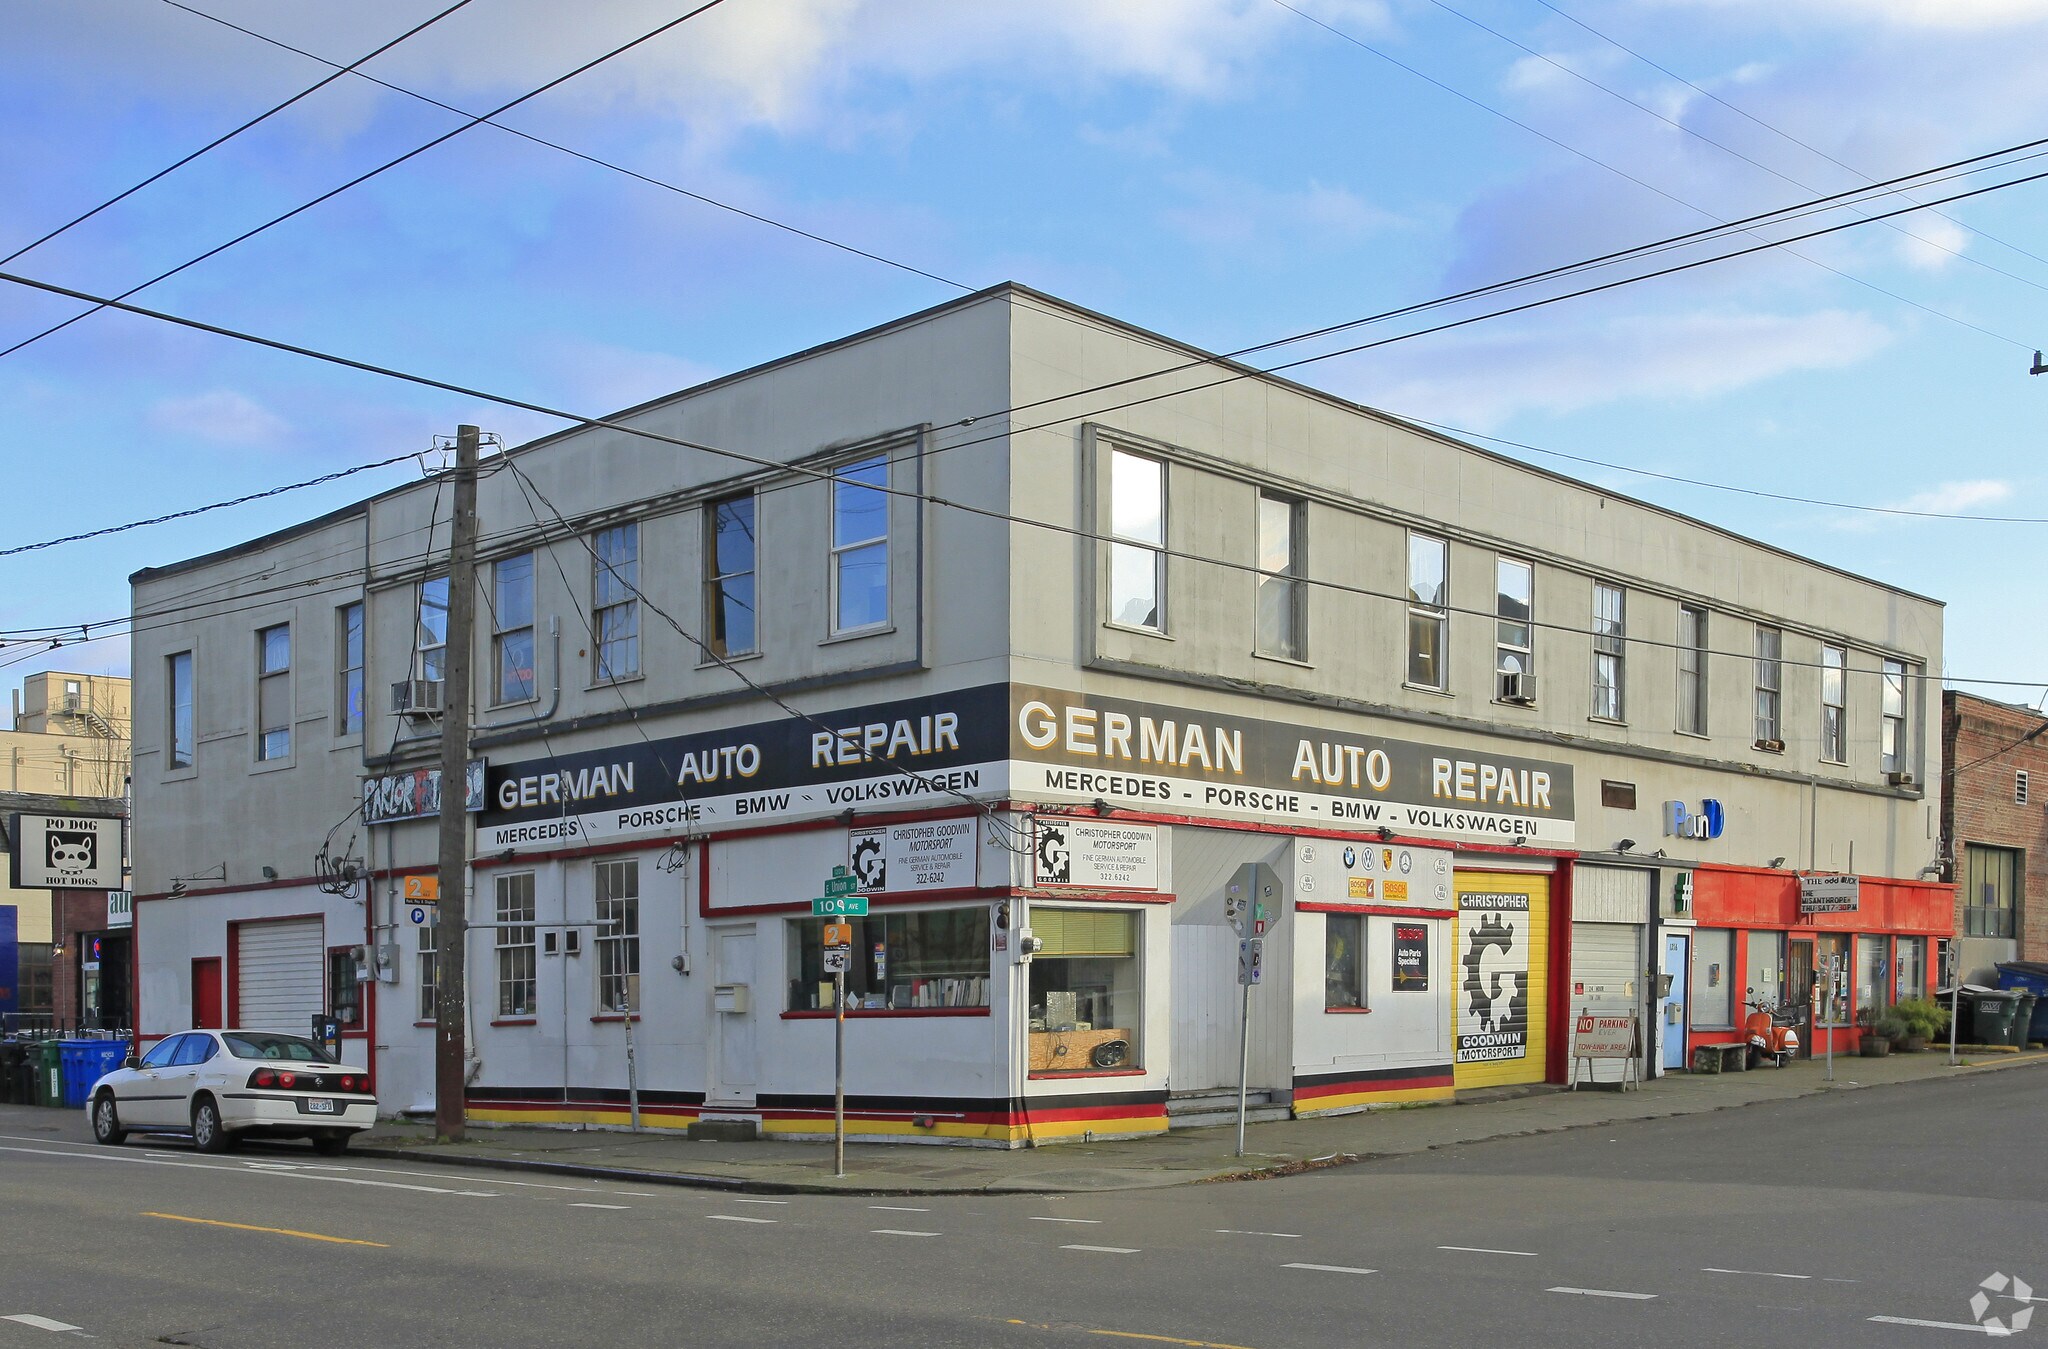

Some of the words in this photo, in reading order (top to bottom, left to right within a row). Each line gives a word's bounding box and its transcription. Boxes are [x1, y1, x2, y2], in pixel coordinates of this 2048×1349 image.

[498, 761, 634, 810] GERMAN
[677, 743, 760, 786] AUTO
[812, 712, 959, 769] REPAIR
[1018, 701, 1242, 775] GERMAN
[1292, 739, 1391, 792] AUTO
[1432, 757, 1551, 809] REPAIR
[496, 821, 578, 845] MERCEDES
[618, 804, 701, 829] PORSCHE
[735, 794, 790, 815] BMW
[827, 770, 979, 804] VOLKSWAGEN
[1045, 769, 1171, 799] MERCEDES
[1205, 787, 1299, 812] PORSCHE
[1331, 801, 1381, 820] BMW
[1406, 808, 1537, 835] VOLKSWAGEN
[46, 818, 64, 829] PO
[69, 820, 97, 831] DOG
[893, 829, 935, 840] CHRISTOPHER
[937, 823, 970, 836] GOODWIN
[1075, 827, 1121, 839] CHRISTOPHER
[1122, 831, 1152, 841] GOODWIN
[909, 838, 953, 851] MOTORSPORT
[1093, 840, 1137, 851] MOTORSPORT
[909, 855, 930, 863] GERMAN
[931, 852, 963, 861] AUTOMOBILE
[1082, 853, 1094, 861] FINE
[1094, 854, 1115, 863] GERMAN
[1116, 855, 1146, 864] AUTOMOBILE
[1093, 863, 1114, 871] SERVICE
[46, 876, 67, 885] HOT
[916, 872, 944, 884] 322-6242
[1350, 880, 1366, 888] BOSCH
[410, 878, 421, 896] 2
[826, 885, 829, 893] E
[832, 881, 847, 893] Union
[1384, 882, 1406, 893] BOSCH
[1461, 894, 1527, 908] CHRISTOPHER
[828, 926, 839, 944] 2
[1398, 949, 1408, 957] Auto
[1409, 949, 1421, 957] Parts
[1398, 957, 1420, 966] Specialist
[1579, 1019, 1592, 1030] NO
[1599, 1019, 1628, 1029] PARKING
[1463, 1032, 1520, 1047] GOODWIN
[1461, 1046, 1518, 1060] MOTORSPORT
[1578, 1043, 1608, 1051] TOW-AWAY
[1610, 1043, 1627, 1051] AREA
